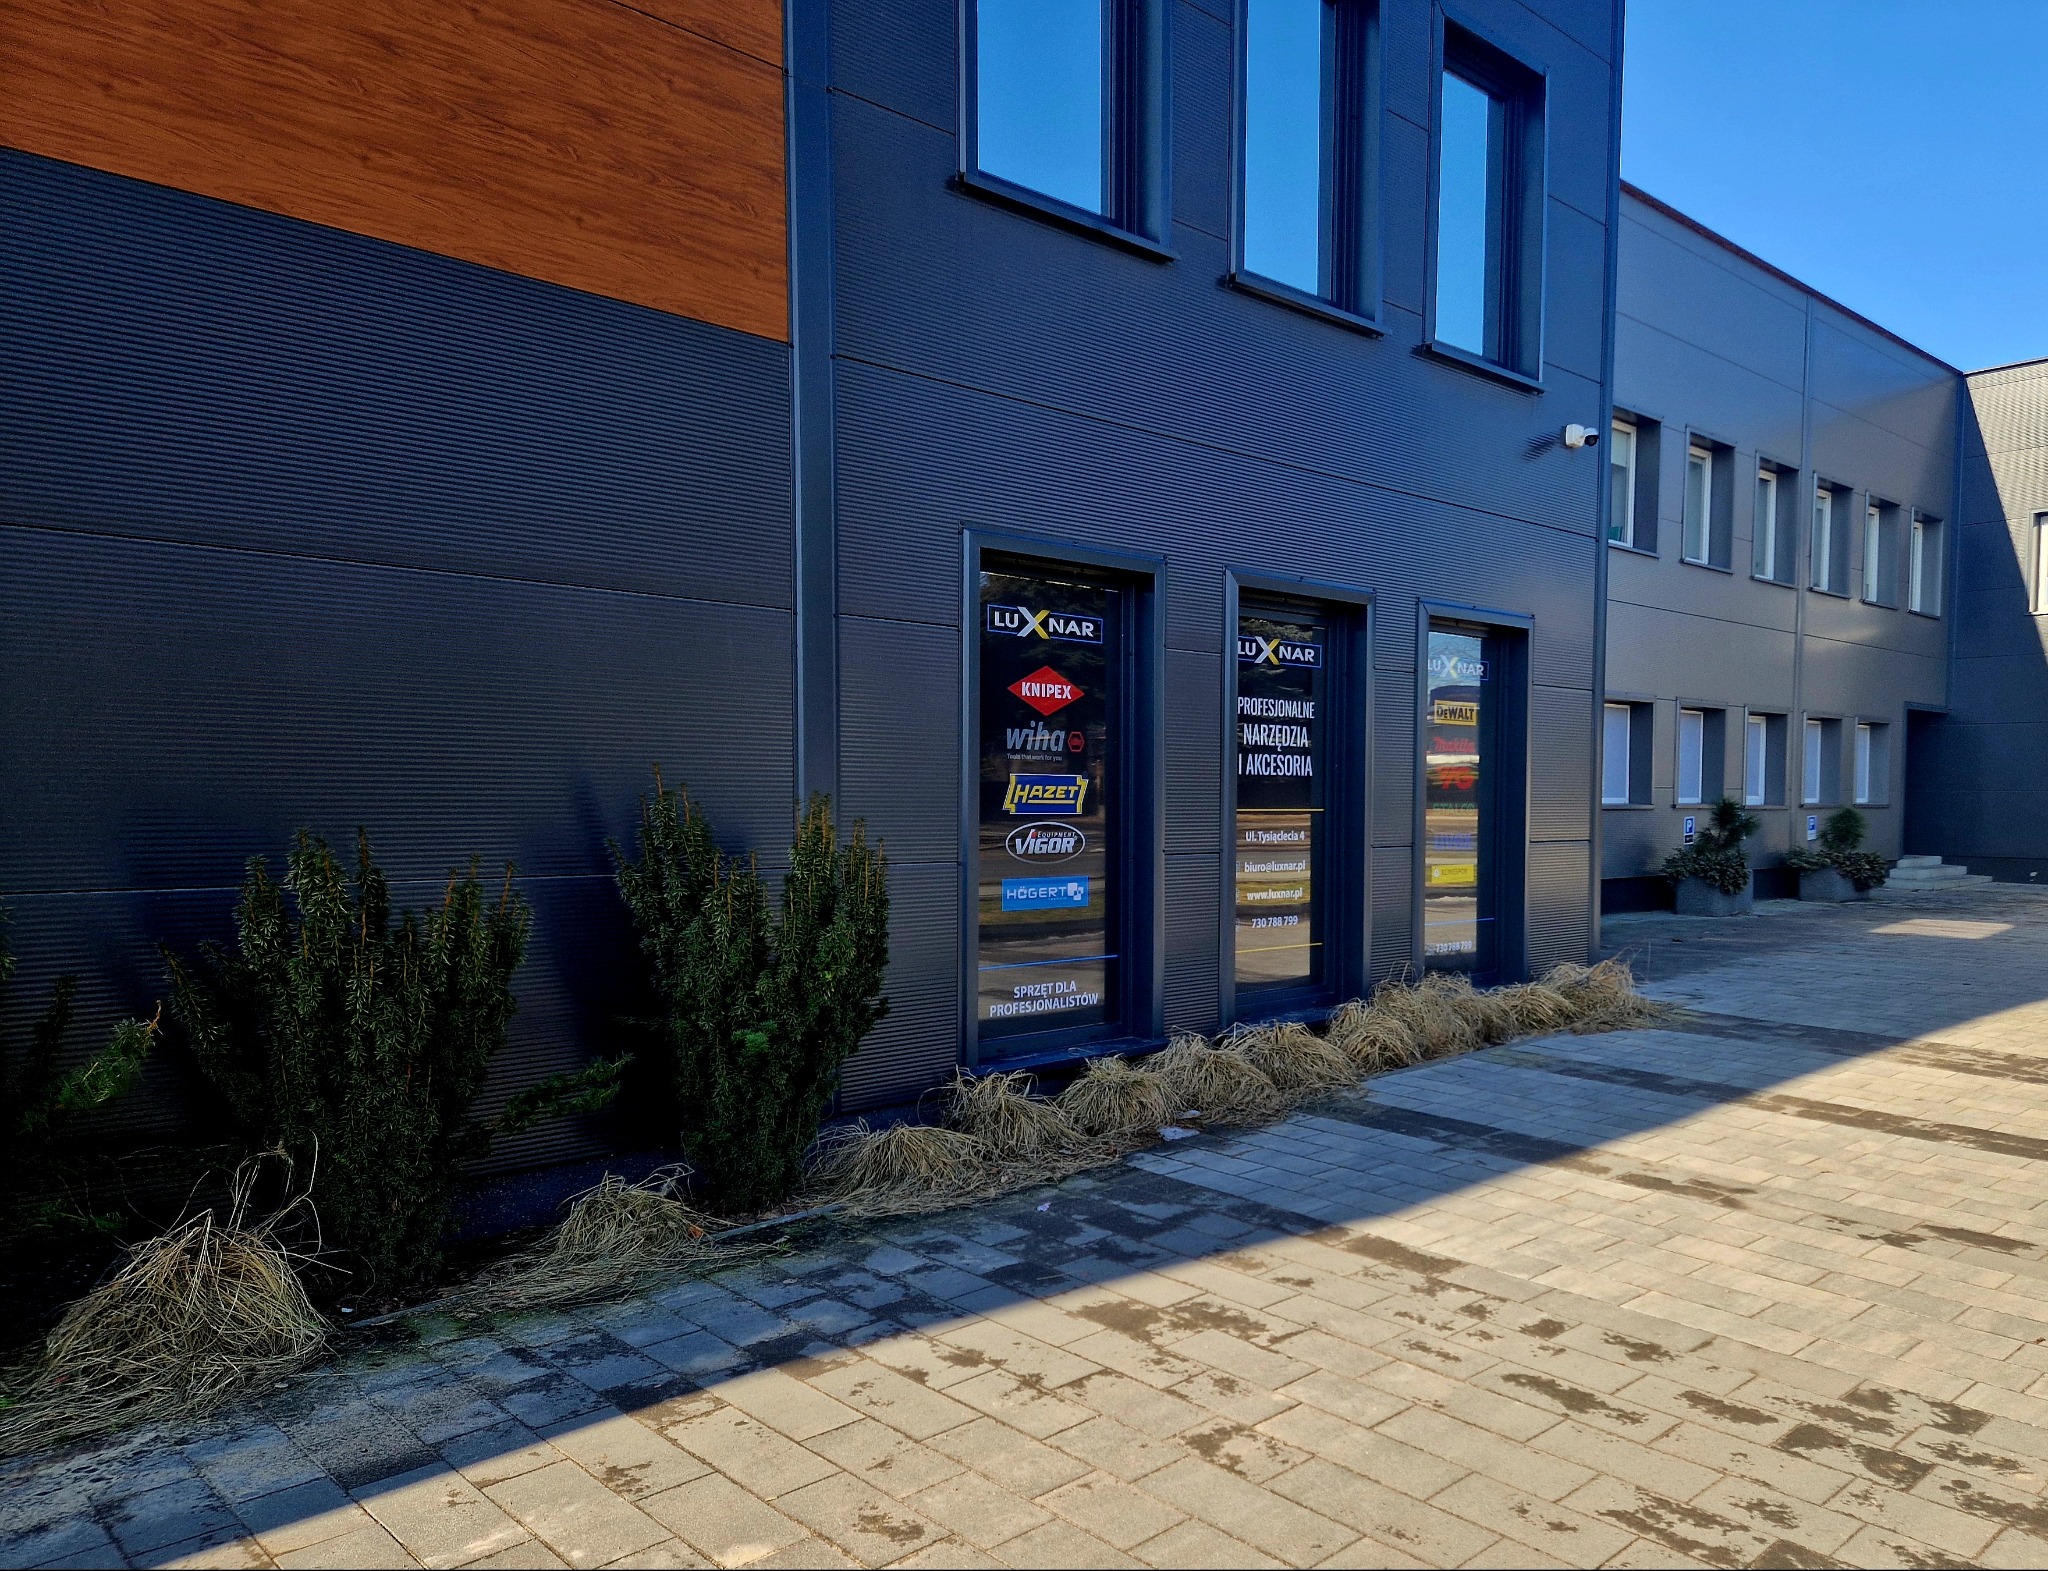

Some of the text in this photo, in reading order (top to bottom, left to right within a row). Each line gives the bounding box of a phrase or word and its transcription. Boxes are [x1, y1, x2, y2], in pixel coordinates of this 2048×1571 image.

[994, 606, 1094, 639] LUXNAR
[1237, 636, 1315, 665] LUXNAR
[1428, 655, 1484, 678] LUXNAR
[1021, 681, 1072, 700] KNIPEX
[1237, 696, 1316, 719] PROFESJONALNE
[1243, 723, 1309, 752] NARZĘDZIA
[1238, 753, 1313, 777] I AKCESORIA
[1013, 784, 1079, 803] HAZET
[1686, 819, 1693, 833] P
[1015, 829, 1075, 855] VIGOR
[1245, 831, 1305, 844] Ul. Tysiąclecia 4
[1244, 860, 1306, 873] biuro@luxnar.pl
[1006, 885, 1067, 900] HÖGERT
[1247, 887, 1303, 901] www.luxnar.pl
[1251, 915, 1299, 929] 730 788 799
[1013, 980, 1077, 999] SPRZĘT DLA
[990, 992, 1099, 1017] PROFESJONALISTÓW
